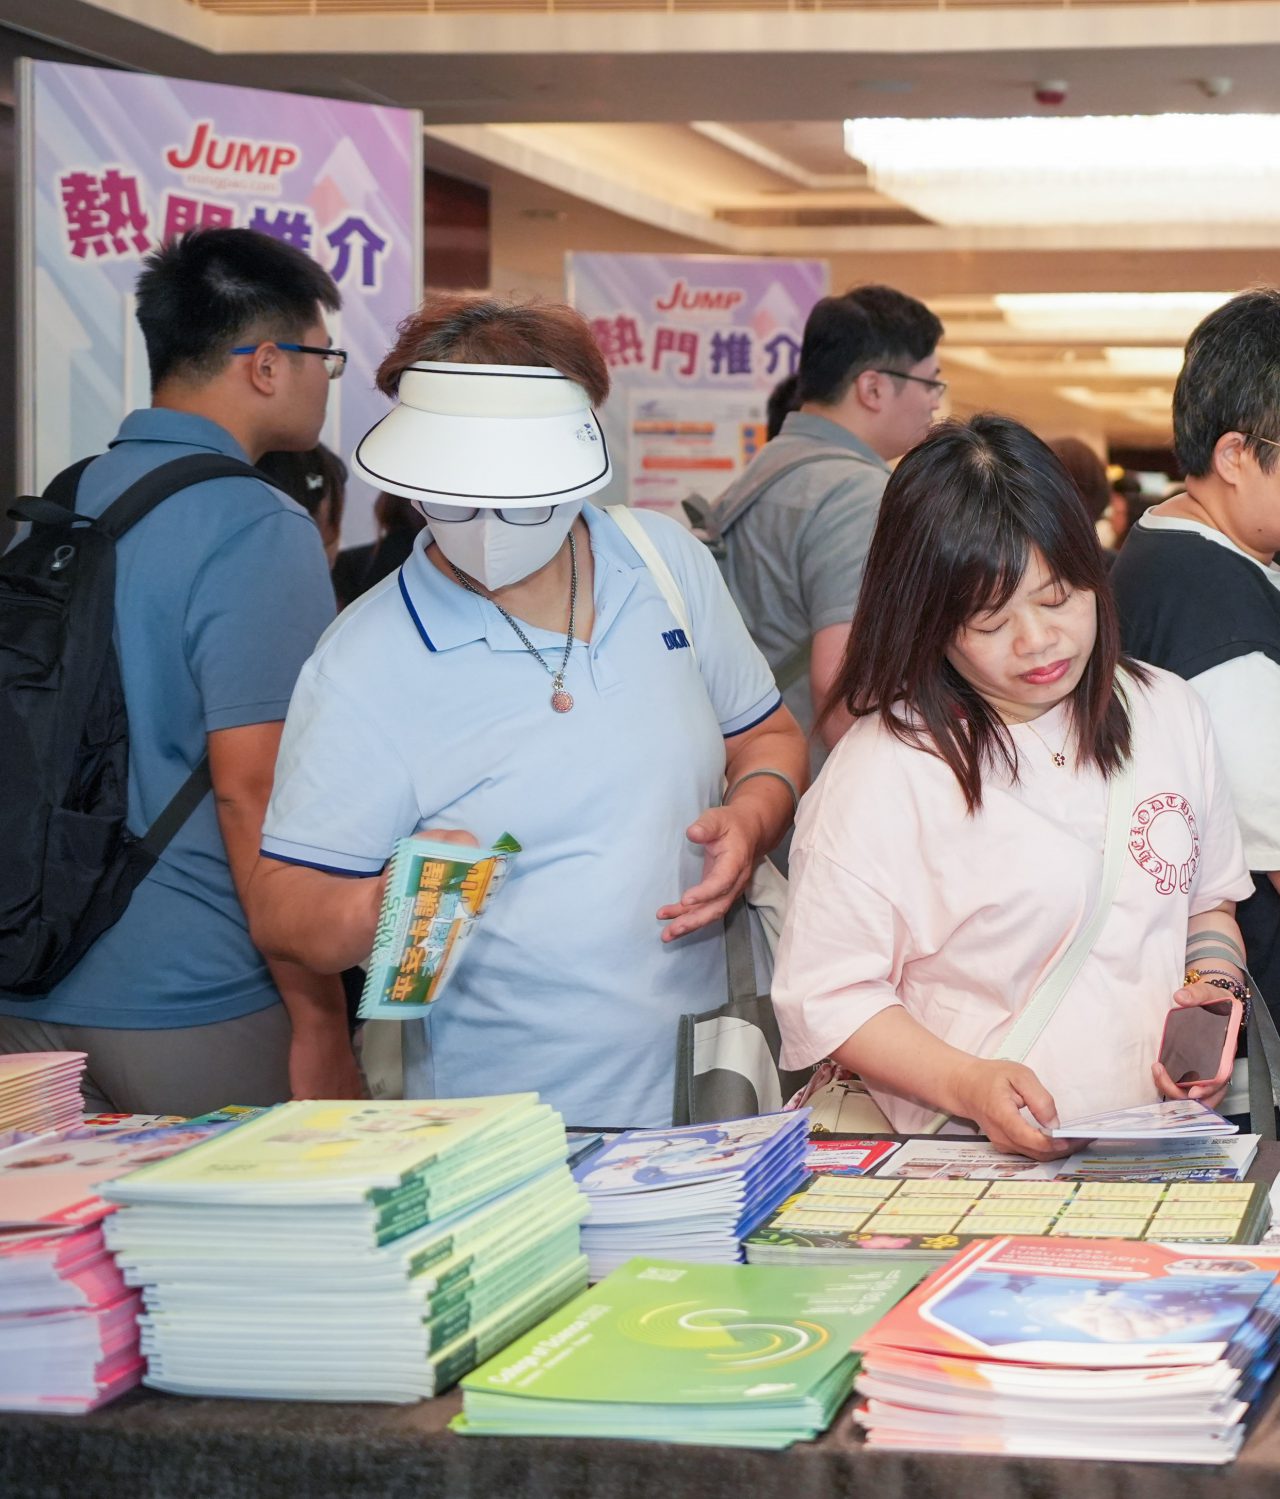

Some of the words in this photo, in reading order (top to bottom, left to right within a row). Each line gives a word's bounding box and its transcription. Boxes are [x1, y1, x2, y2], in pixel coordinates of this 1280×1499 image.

[167, 123, 297, 176] JUMP
[656, 281, 742, 311] JUMP
[590, 316, 801, 376] 熱門推介
[390, 861, 446, 1002] 平安卡課程
